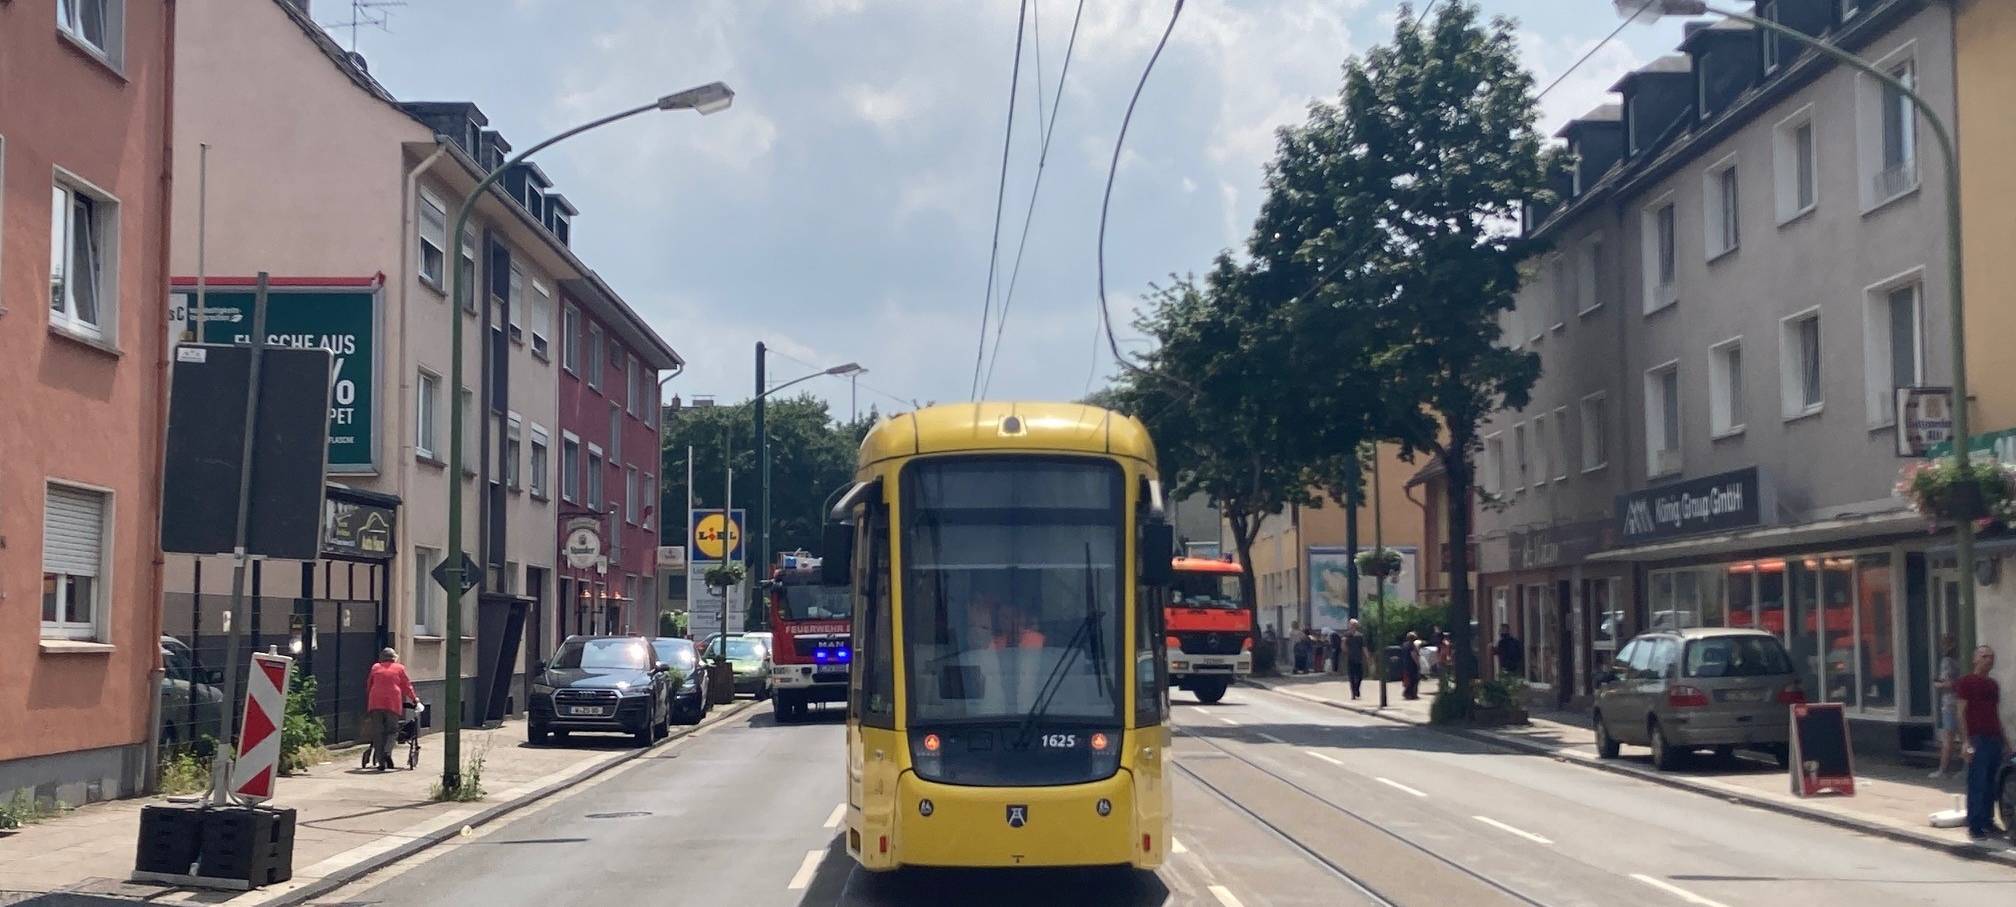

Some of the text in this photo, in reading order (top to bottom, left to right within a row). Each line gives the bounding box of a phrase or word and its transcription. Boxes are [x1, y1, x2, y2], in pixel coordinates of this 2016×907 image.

[320, 334, 355, 354] AUS
[1681, 492, 1709, 522] Group
[1710, 482, 1743, 514] GmbH
[785, 624, 845, 634] FEUERWEHR
[1042, 734, 1076, 748] 1625
